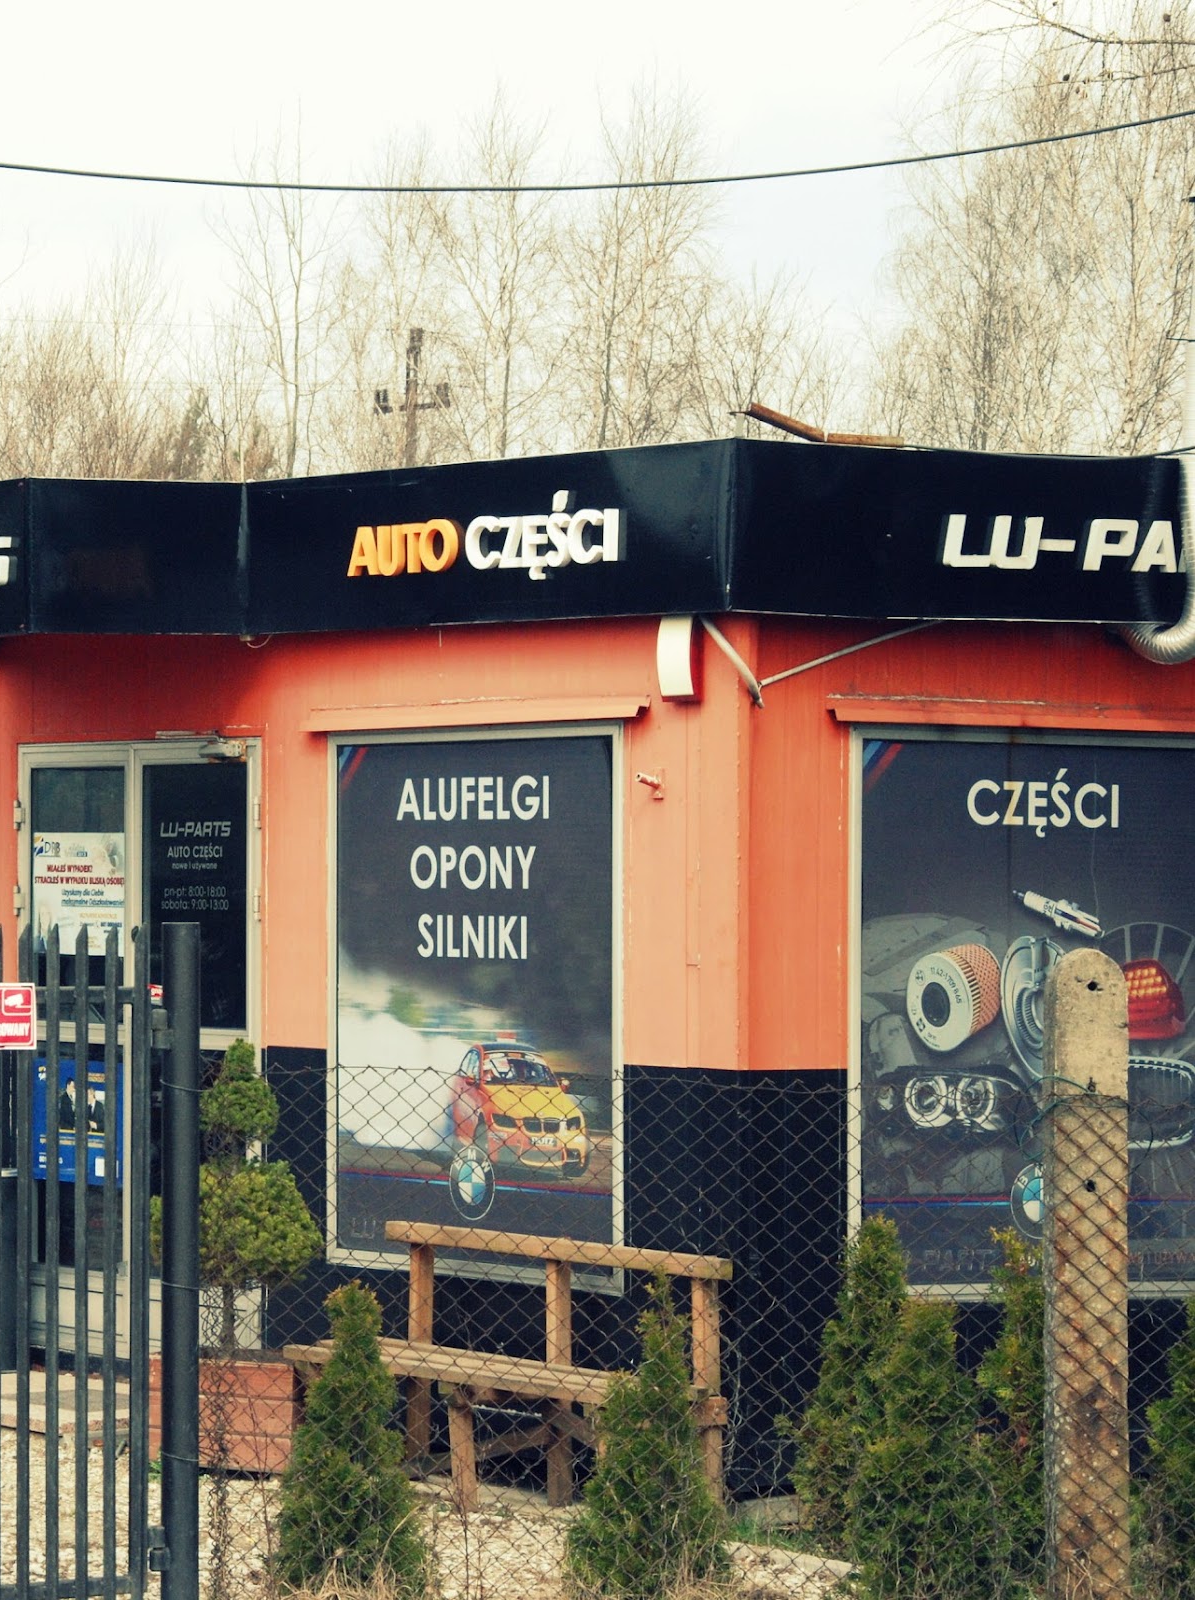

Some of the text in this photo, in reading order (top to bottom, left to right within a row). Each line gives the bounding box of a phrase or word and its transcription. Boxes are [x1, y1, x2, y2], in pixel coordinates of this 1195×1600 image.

[347, 490, 620, 580] AUTO CZĘŚCI
[941, 514, 1187, 573] LU-PA
[396, 775, 550, 821] ALUFELGI
[967, 768, 1120, 838] CZĘŚCI
[160, 821, 232, 837] LU-PARTS
[167, 842, 223, 860] AUTO CZĘŚCI
[410, 845, 537, 890] OPONY
[417, 913, 528, 960] SILNIKI
